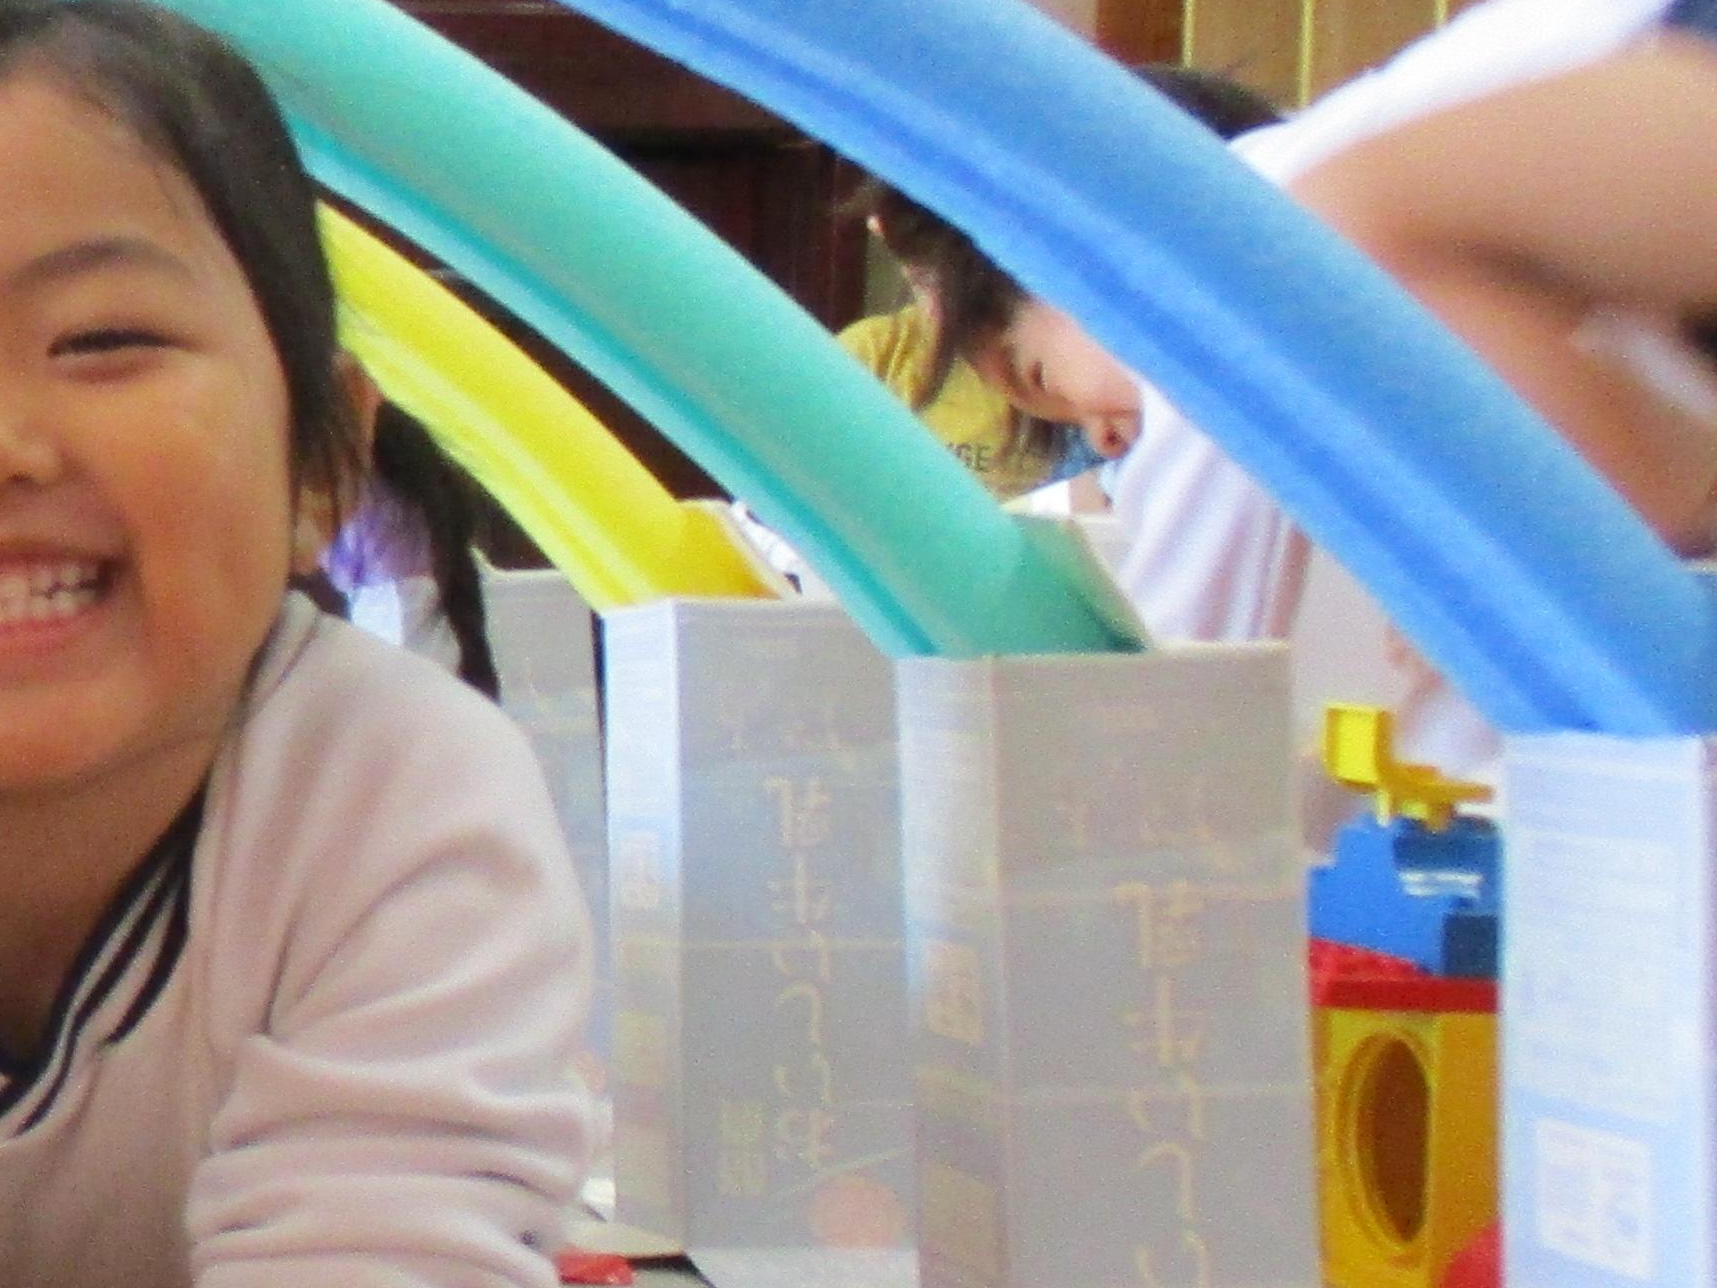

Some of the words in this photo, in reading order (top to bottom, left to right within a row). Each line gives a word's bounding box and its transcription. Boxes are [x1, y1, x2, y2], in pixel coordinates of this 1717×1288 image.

[763, 775, 835, 1170] おいしい牛乳
